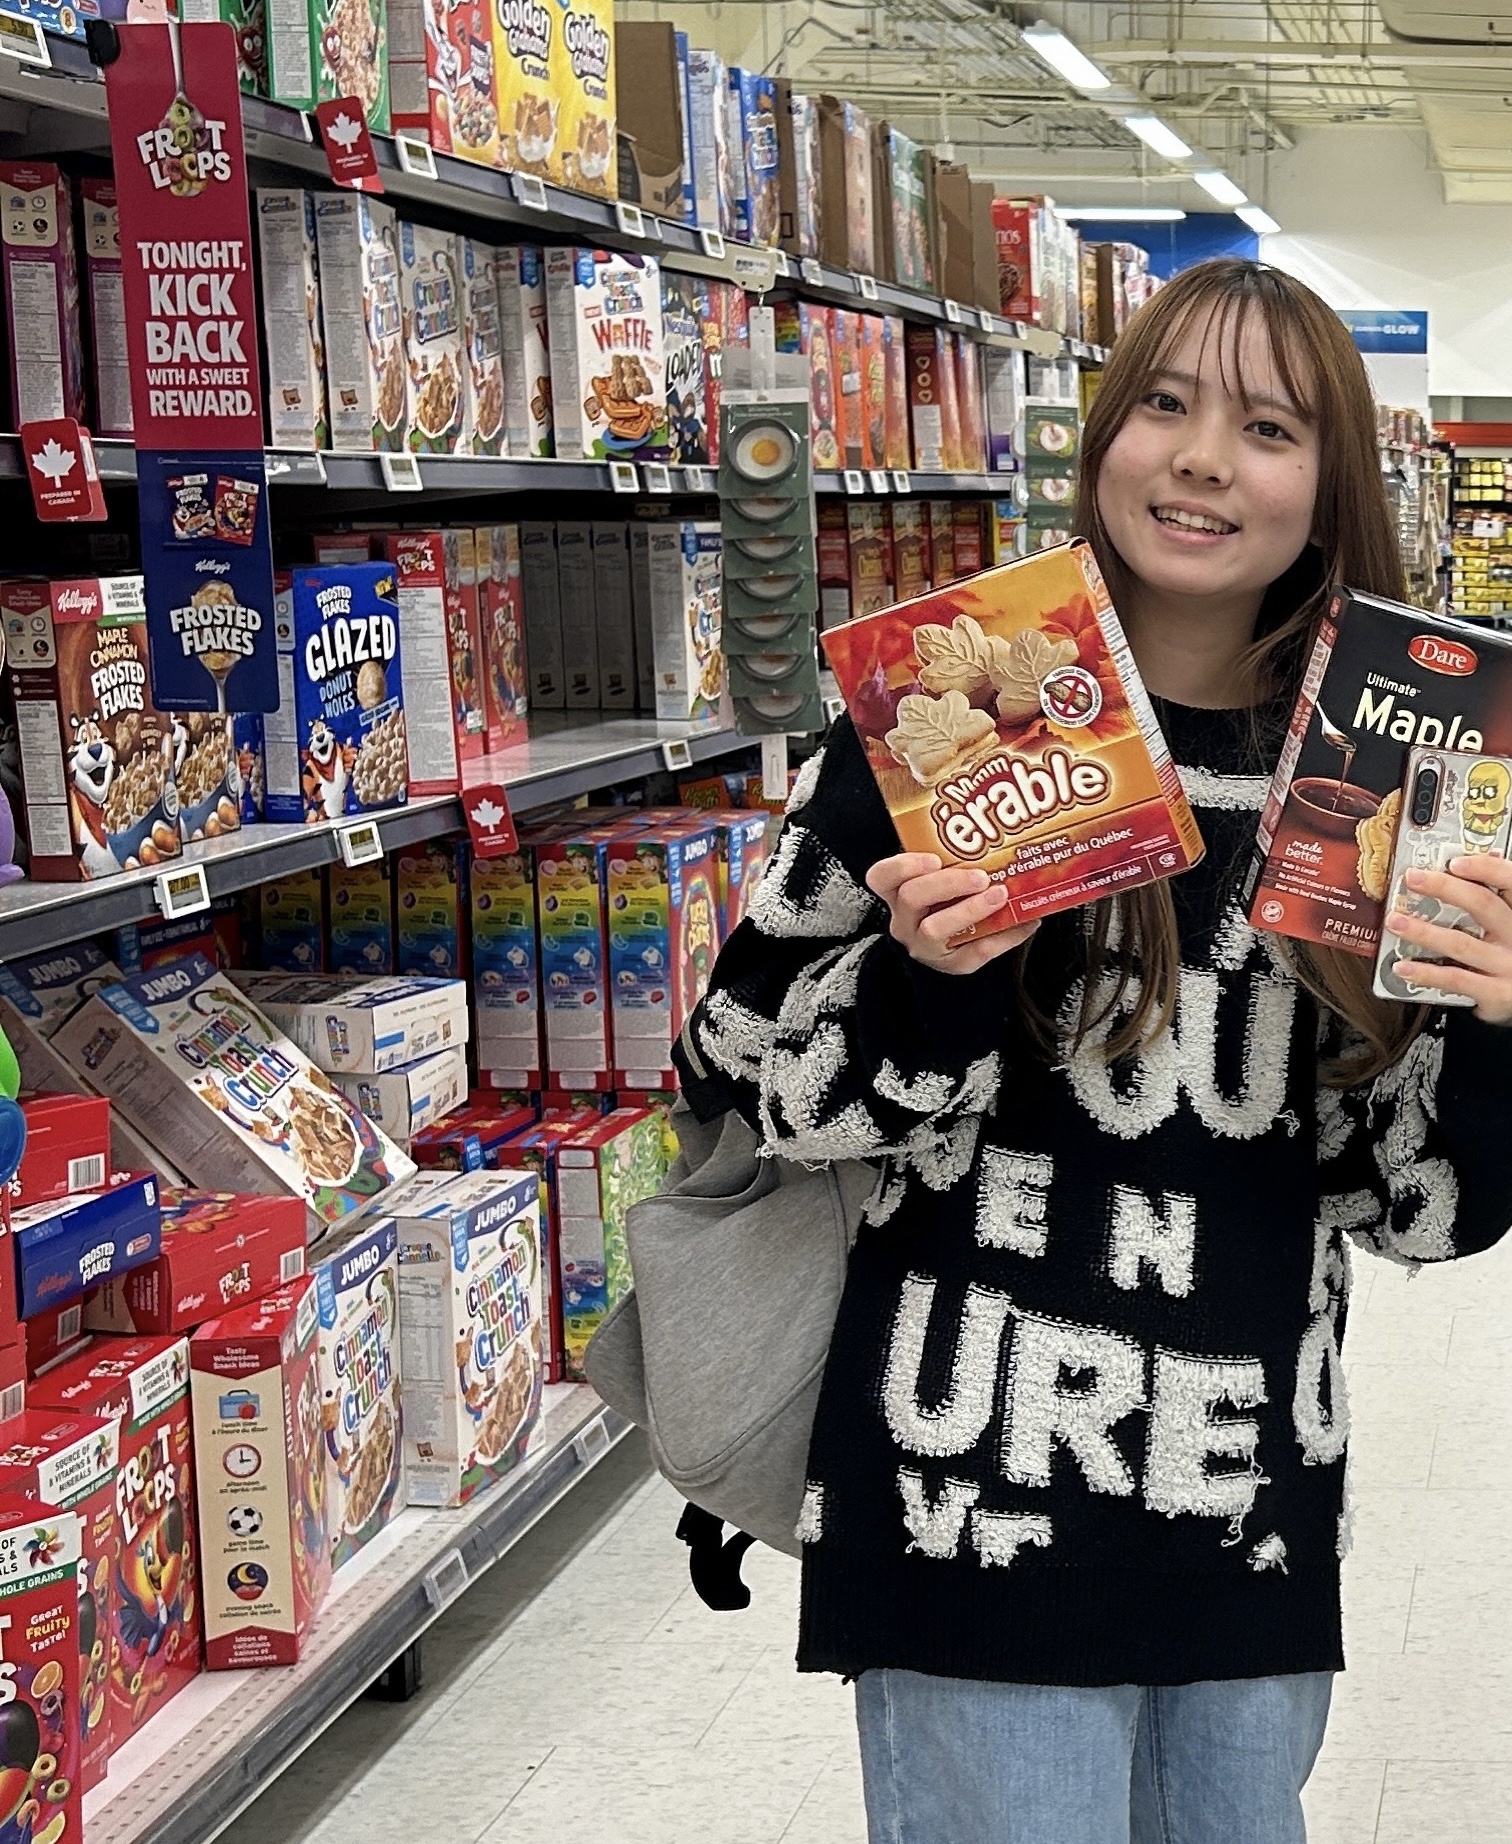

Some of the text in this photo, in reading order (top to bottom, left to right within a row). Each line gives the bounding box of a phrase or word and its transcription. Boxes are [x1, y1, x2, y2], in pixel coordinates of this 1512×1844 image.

[137, 240, 246, 271] TONIGHT,
[150, 273, 238, 317] KICK
[145, 320, 248, 364] BACK
[1383, 324, 1421, 335] GLOW
[146, 367, 250, 386] WITH A SWEET
[150, 389, 257, 418] REWARD.
[195, 559, 231, 574] Kellogg's
[57, 588, 98, 615] Kellogg's
[316, 585, 352, 610] FROSTED
[321, 600, 351, 621] FLAKES
[170, 604, 262, 633] FROSTED
[96, 627, 129, 648] MAPLE
[181, 626, 255, 657] FLAKES
[305, 614, 397, 682] GLAZED
[89, 644, 138, 668] CINNAMON
[1418, 640, 1469, 670] Dare
[90, 660, 146, 698] FROSTED
[319, 670, 353, 702] DONUT
[100, 684, 145, 721] FLAKES
[324, 691, 356, 719] HOLES
[1352, 687, 1485, 754] Maple
[944, 755, 1010, 804] Mmm
[939, 751, 1106, 852] érable
[1007, 826, 1135, 877] d'érable pur du Québec
[1016, 836, 1070, 860] faits avec
[1292, 840, 1323, 854] made
[140, 969, 192, 1001] JUMBO
[222, 1044, 299, 1111] Crunch
[474, 1194, 517, 1233] JUMBO
[79, 1241, 115, 1274] FROSTED
[82, 1258, 112, 1286] FLAKES
[340, 1244, 381, 1286] JUMBO
[466, 1241, 529, 1318] Cinnamon
[481, 1274, 522, 1332] Toast
[333, 1292, 389, 1379] Cinnamon
[475, 1292, 530, 1373] Crunch
[224, 1346, 248, 1355] Tasty
[347, 1327, 384, 1391] Toast
[342, 1346, 392, 1436] Crunch
[55, 1442, 91, 1471] SOURCE OF
[116, 1423, 171, 1517] FROOT
[59, 1466, 92, 1494] MINERALS
[27, 1569, 65, 1590] GRAINS
